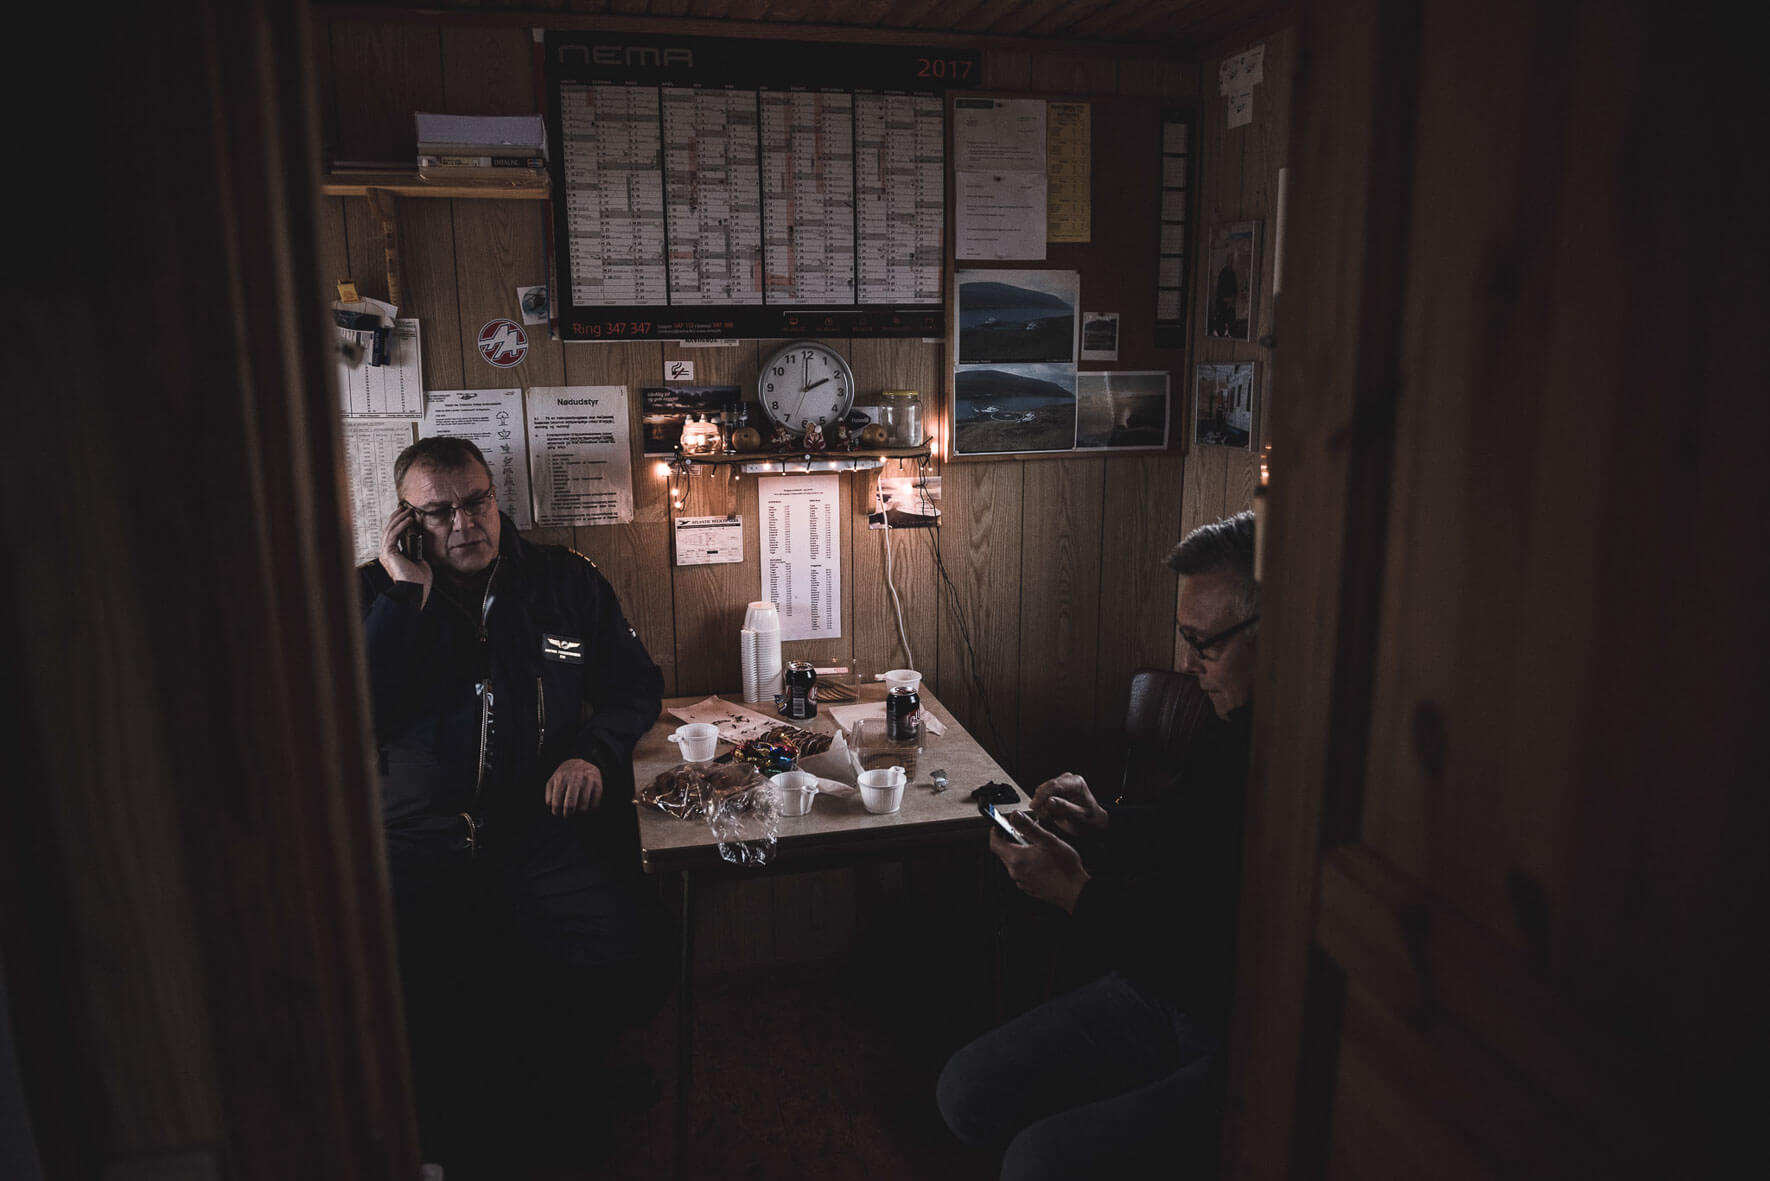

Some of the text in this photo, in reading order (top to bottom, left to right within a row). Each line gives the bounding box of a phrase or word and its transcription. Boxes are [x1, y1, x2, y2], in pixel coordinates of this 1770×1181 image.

[558, 44, 694, 68] NEMA
[916, 57, 973, 80] 2017
[572, 320, 652, 337] Ring 347 347
[784, 354, 796, 364] 11
[801, 350, 815, 360] 12
[823, 356, 828, 366] 1
[772, 366, 785, 377] 10
[833, 370, 841, 380] 2
[767, 383, 774, 393] 9
[837, 387, 844, 397] 3
[557, 398, 599, 407] Nødudstyr
[772, 401, 779, 410] 8
[831, 403, 838, 413] 4
[784, 413, 791, 422] 7
[819, 416, 827, 425] 5
